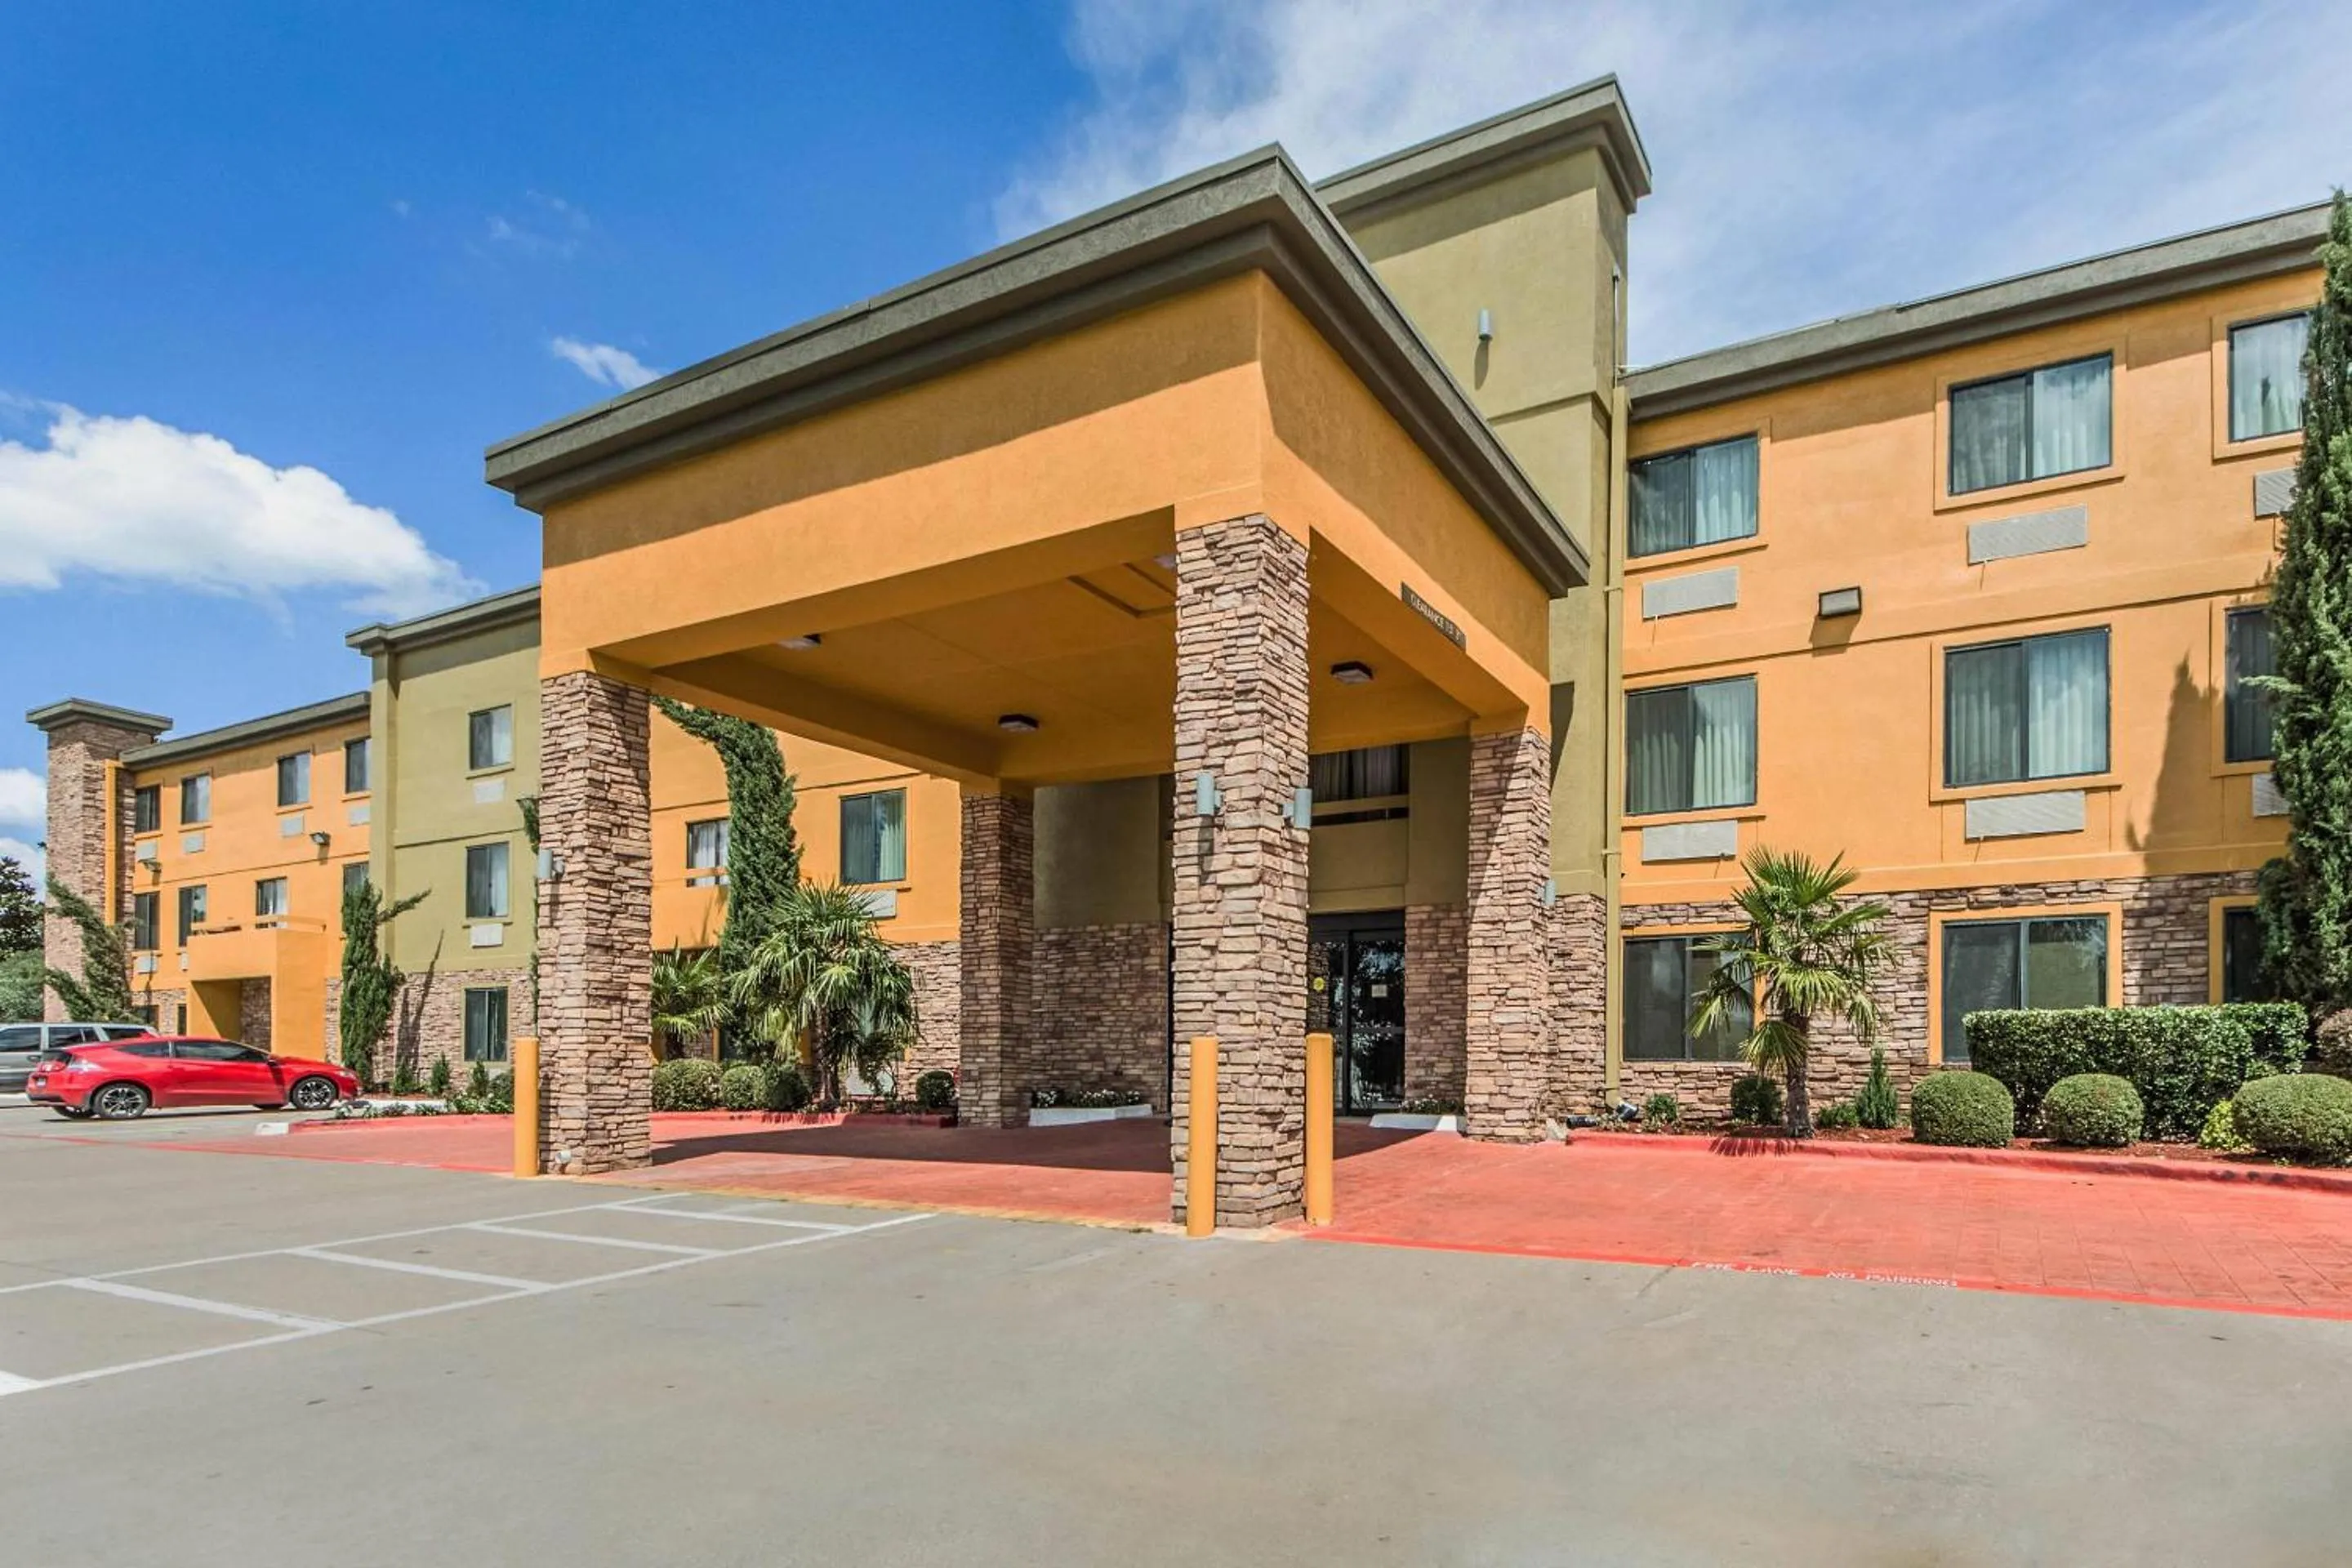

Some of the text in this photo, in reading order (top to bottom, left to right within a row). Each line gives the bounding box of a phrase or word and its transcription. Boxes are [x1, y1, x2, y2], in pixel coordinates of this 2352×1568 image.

[1410, 594, 1444, 628] CLEARANCE
[1744, 1265, 1800, 1276] LANE
[1826, 1270, 1856, 1280] NO
[1865, 1272, 1958, 1287] PARKING
